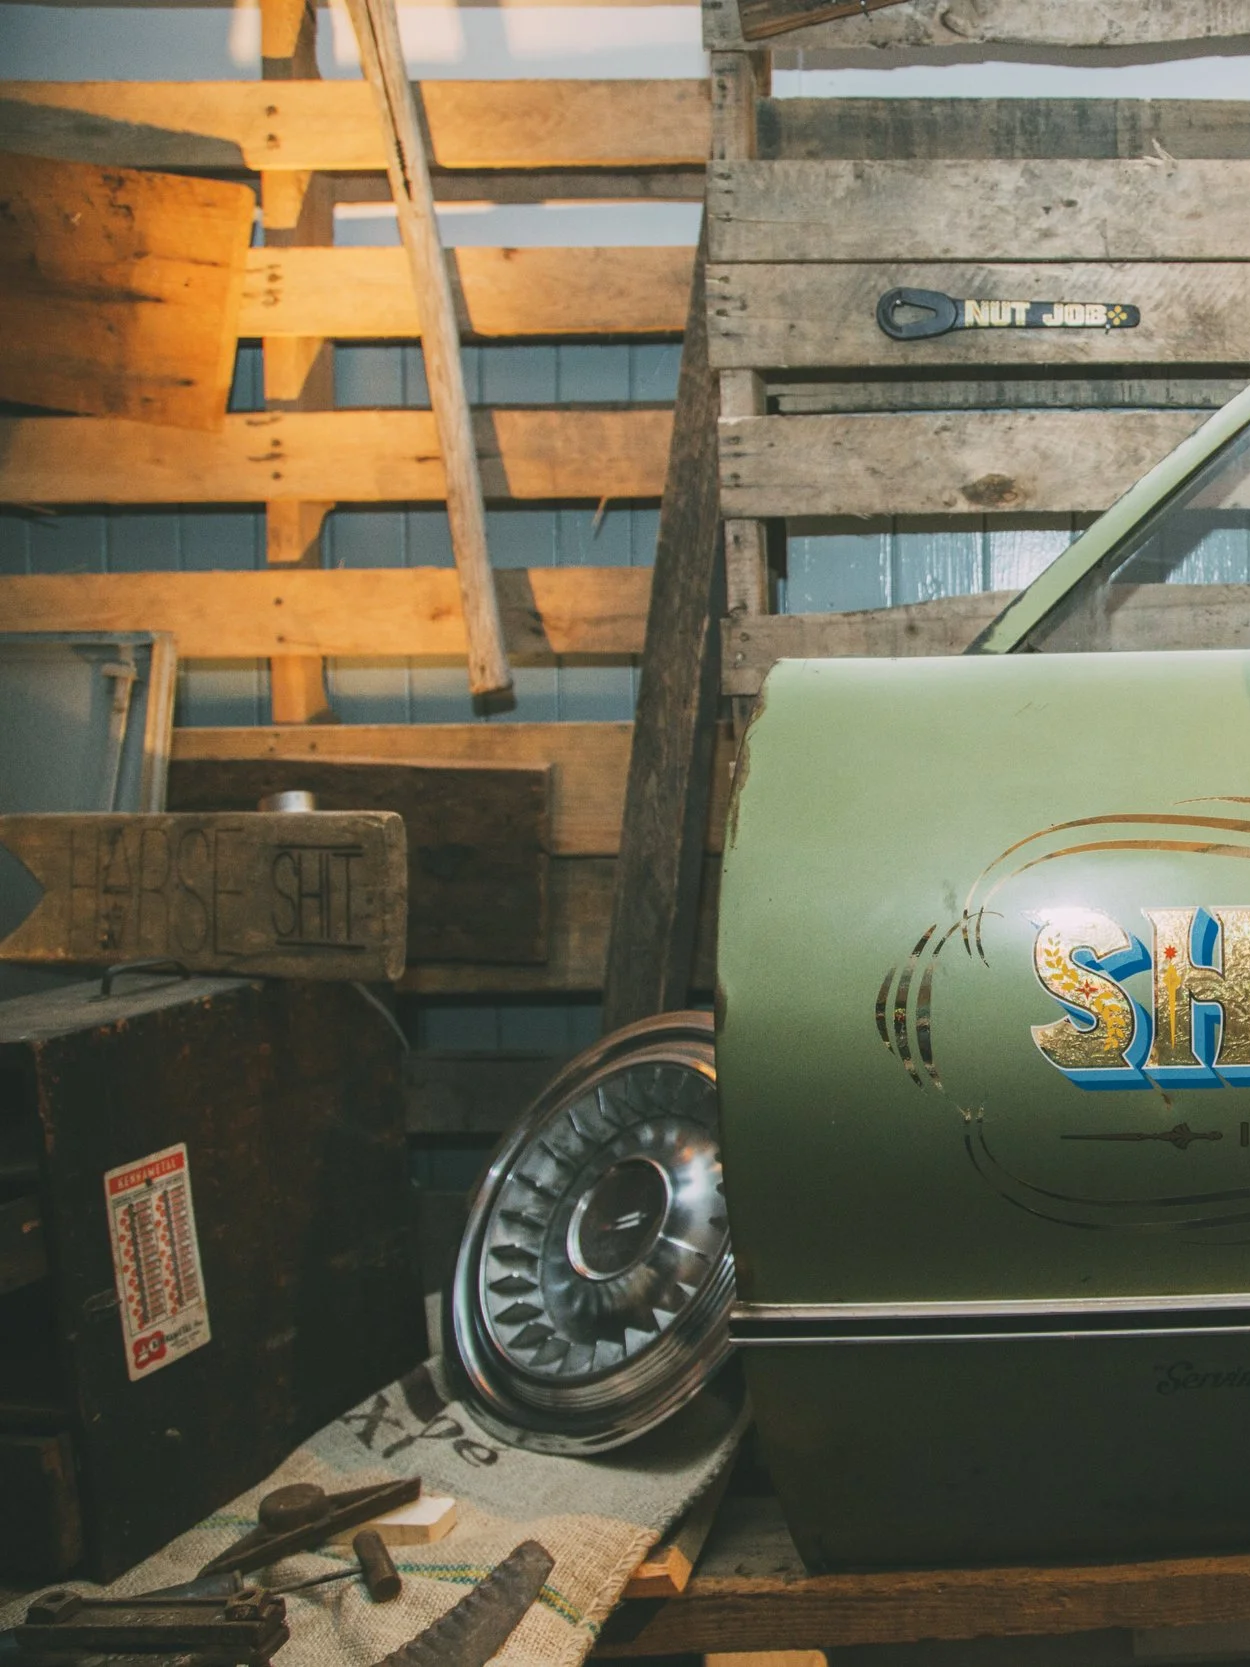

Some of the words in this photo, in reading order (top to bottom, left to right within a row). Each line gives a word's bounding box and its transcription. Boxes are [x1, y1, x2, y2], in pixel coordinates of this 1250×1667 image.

[964, 299, 1031, 327] NUT
[1042, 302, 1108, 327] JOB
[271, 850, 364, 939] SHIT
